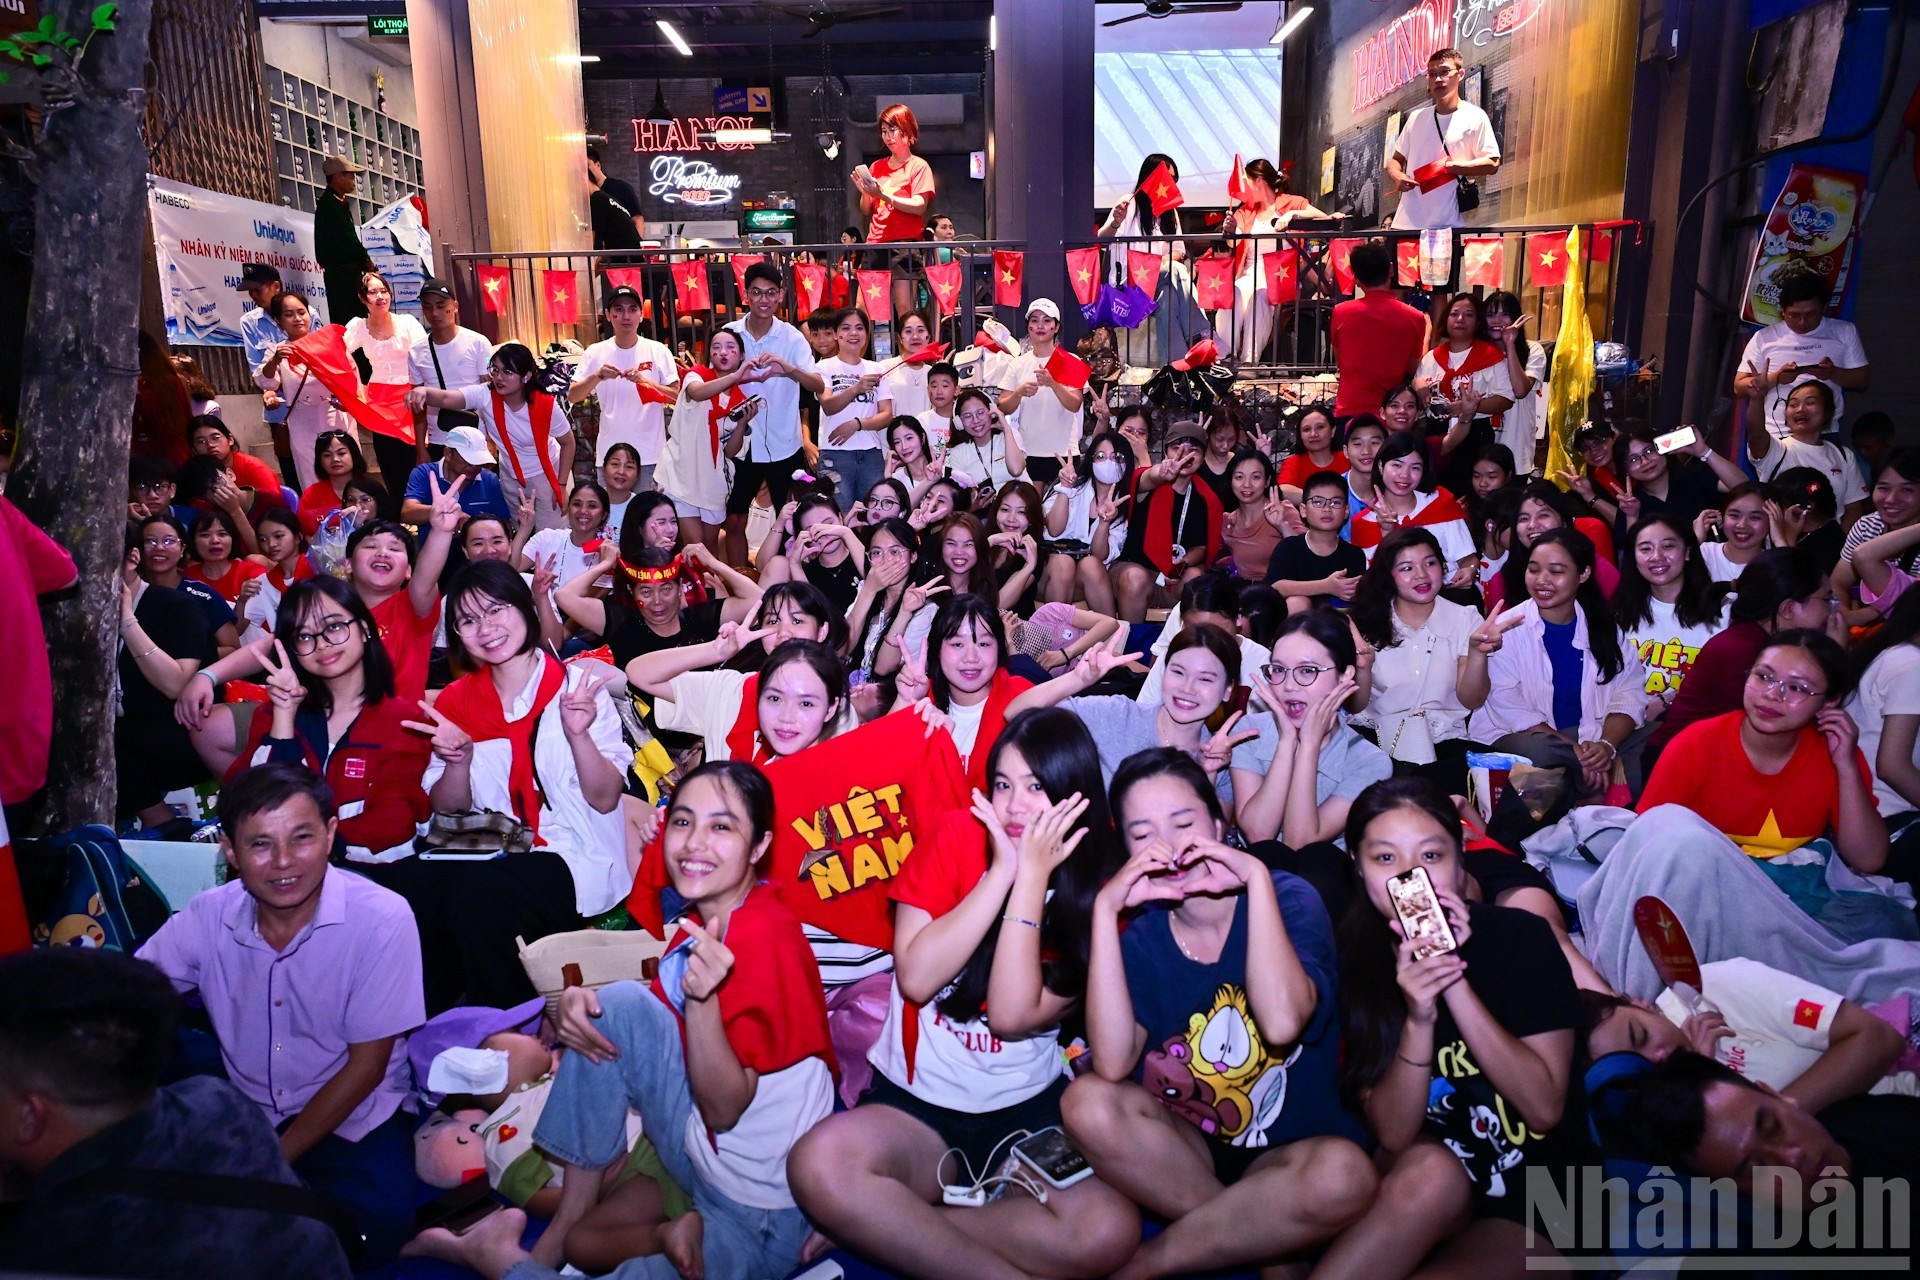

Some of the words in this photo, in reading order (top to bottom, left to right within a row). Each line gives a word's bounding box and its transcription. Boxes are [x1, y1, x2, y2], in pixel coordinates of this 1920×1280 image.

[387, 18, 408, 28] THOÁ
[631, 115, 756, 152] HANOI
[649, 155, 742, 200] Premium
[154, 192, 190, 210] HABECO
[253, 219, 296, 247] UniAqua
[180, 238, 212, 258] NHÂN
[214, 240, 226, 261] KỶ
[267, 251, 288, 269] NĂM
[289, 254, 313, 272] QUỐC
[791, 783, 903, 851] VIỆT
[808, 831, 915, 901] NAM
